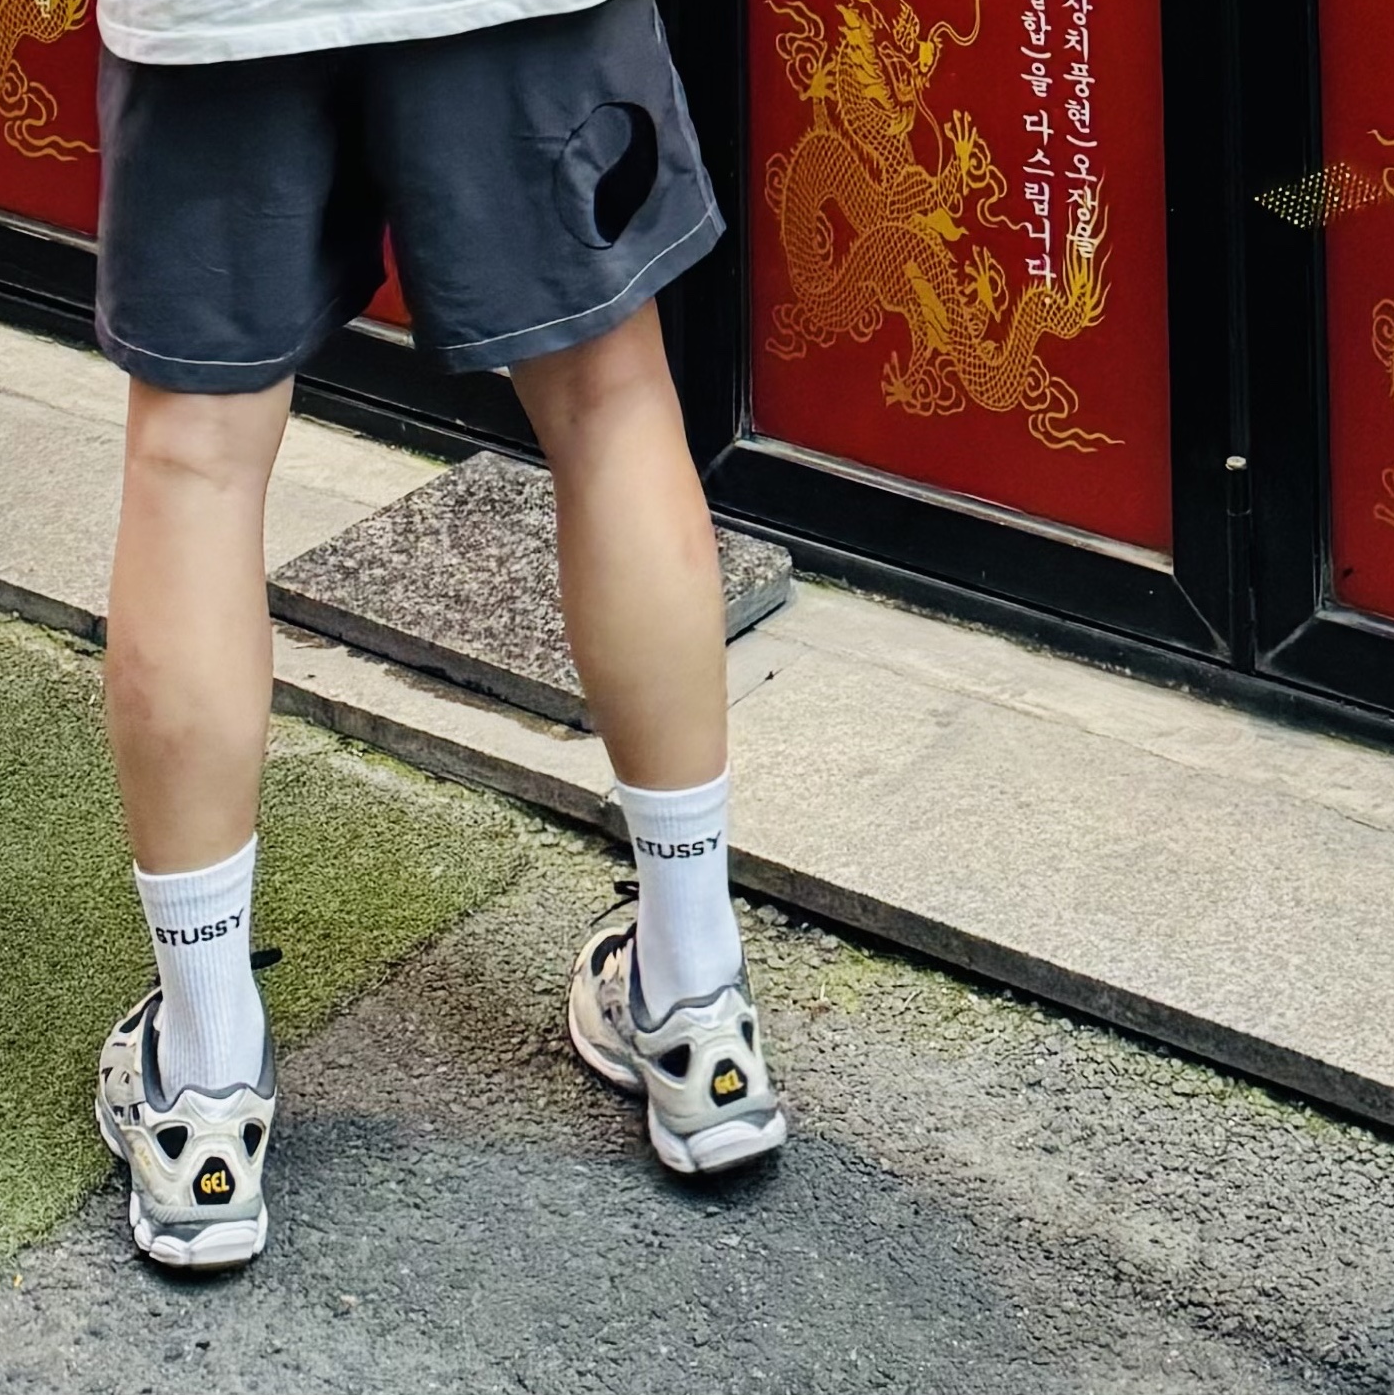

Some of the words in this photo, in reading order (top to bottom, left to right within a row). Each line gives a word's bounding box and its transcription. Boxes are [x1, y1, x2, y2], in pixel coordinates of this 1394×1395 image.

[636, 830, 722, 860] STUSSY
[156, 906, 245, 948] STUSSY
[714, 1067, 743, 1096] GEL
[201, 1171, 231, 1195] GEL
